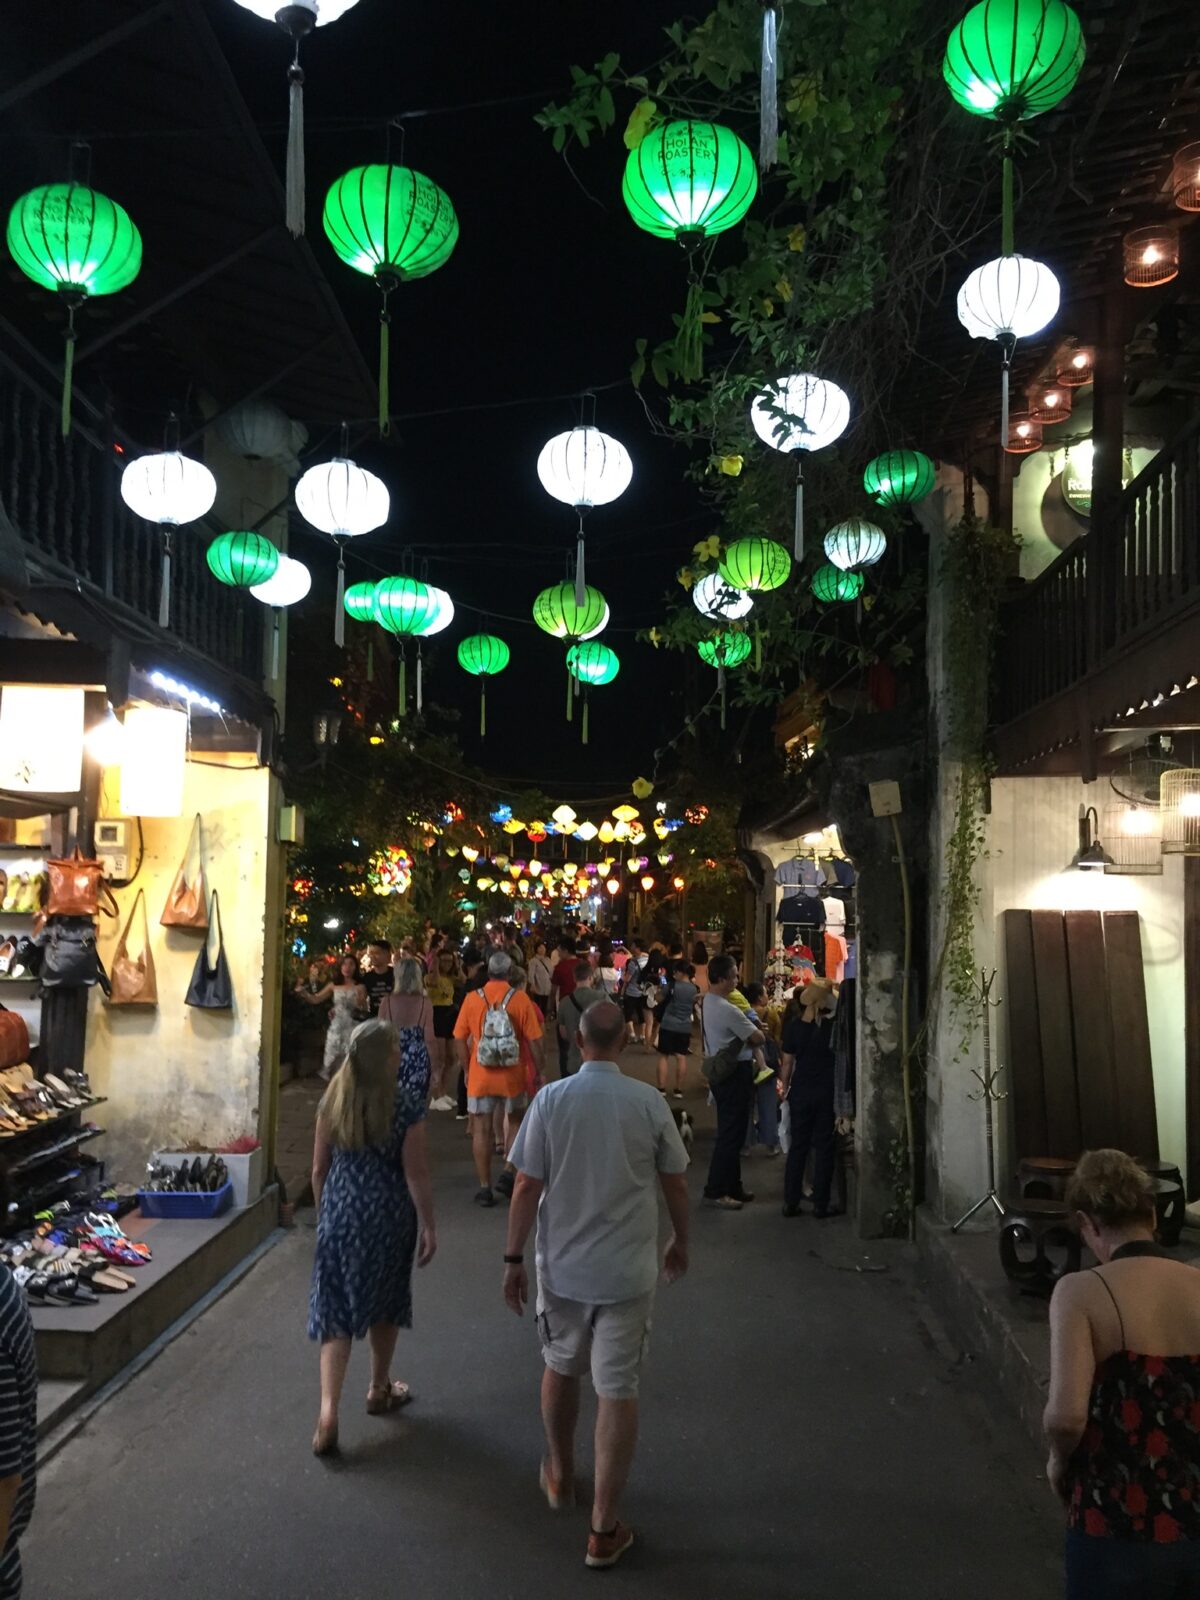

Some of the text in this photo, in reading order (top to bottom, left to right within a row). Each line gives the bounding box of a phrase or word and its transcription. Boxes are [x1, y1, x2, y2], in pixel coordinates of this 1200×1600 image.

[666, 136, 708, 150] HOI AN
[33, 207, 92, 225] ROASERY
